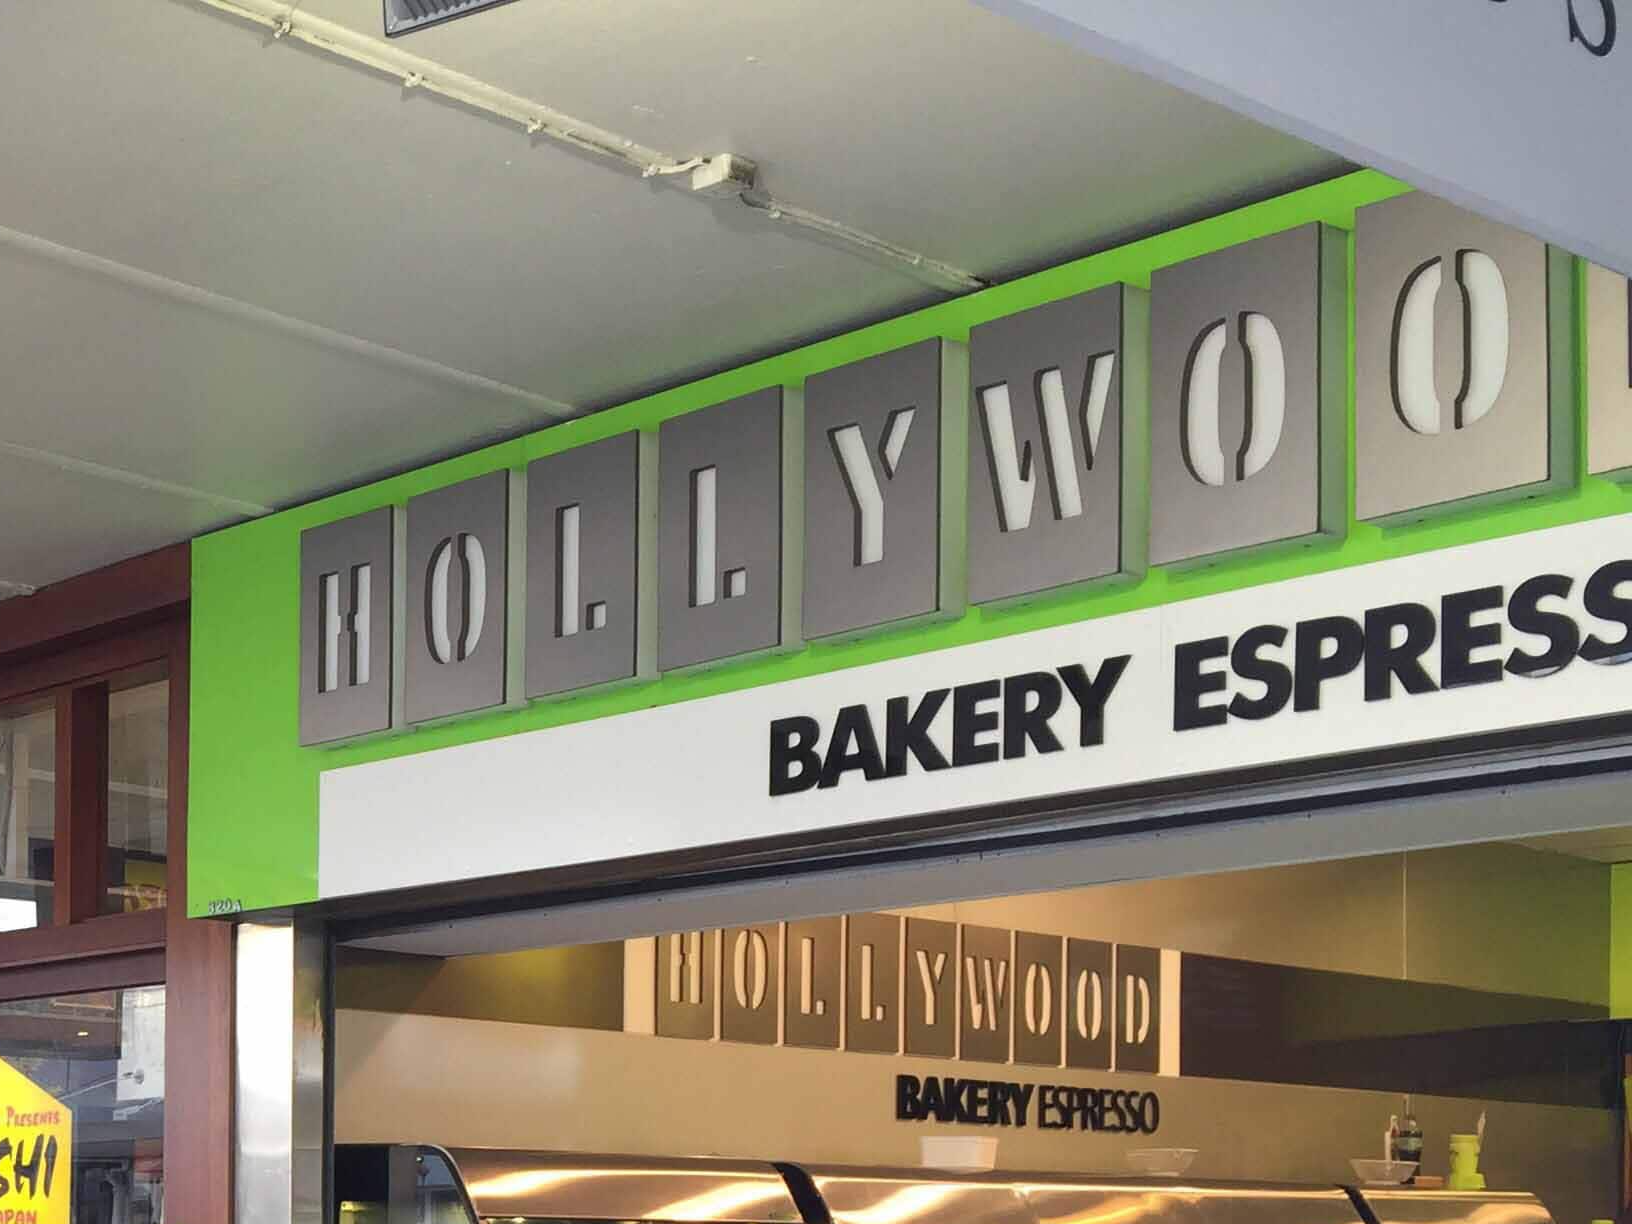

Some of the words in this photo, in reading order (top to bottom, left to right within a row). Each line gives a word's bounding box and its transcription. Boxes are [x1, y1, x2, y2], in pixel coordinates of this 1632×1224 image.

[319, 249, 1632, 693] HOLLYWOO
[769, 654, 1133, 797] BAKERY
[670, 928, 1151, 1044] HOLLYWOOD
[895, 1075, 1035, 1129] BAKERY
[1038, 1083, 1160, 1135] ESPRESSO
